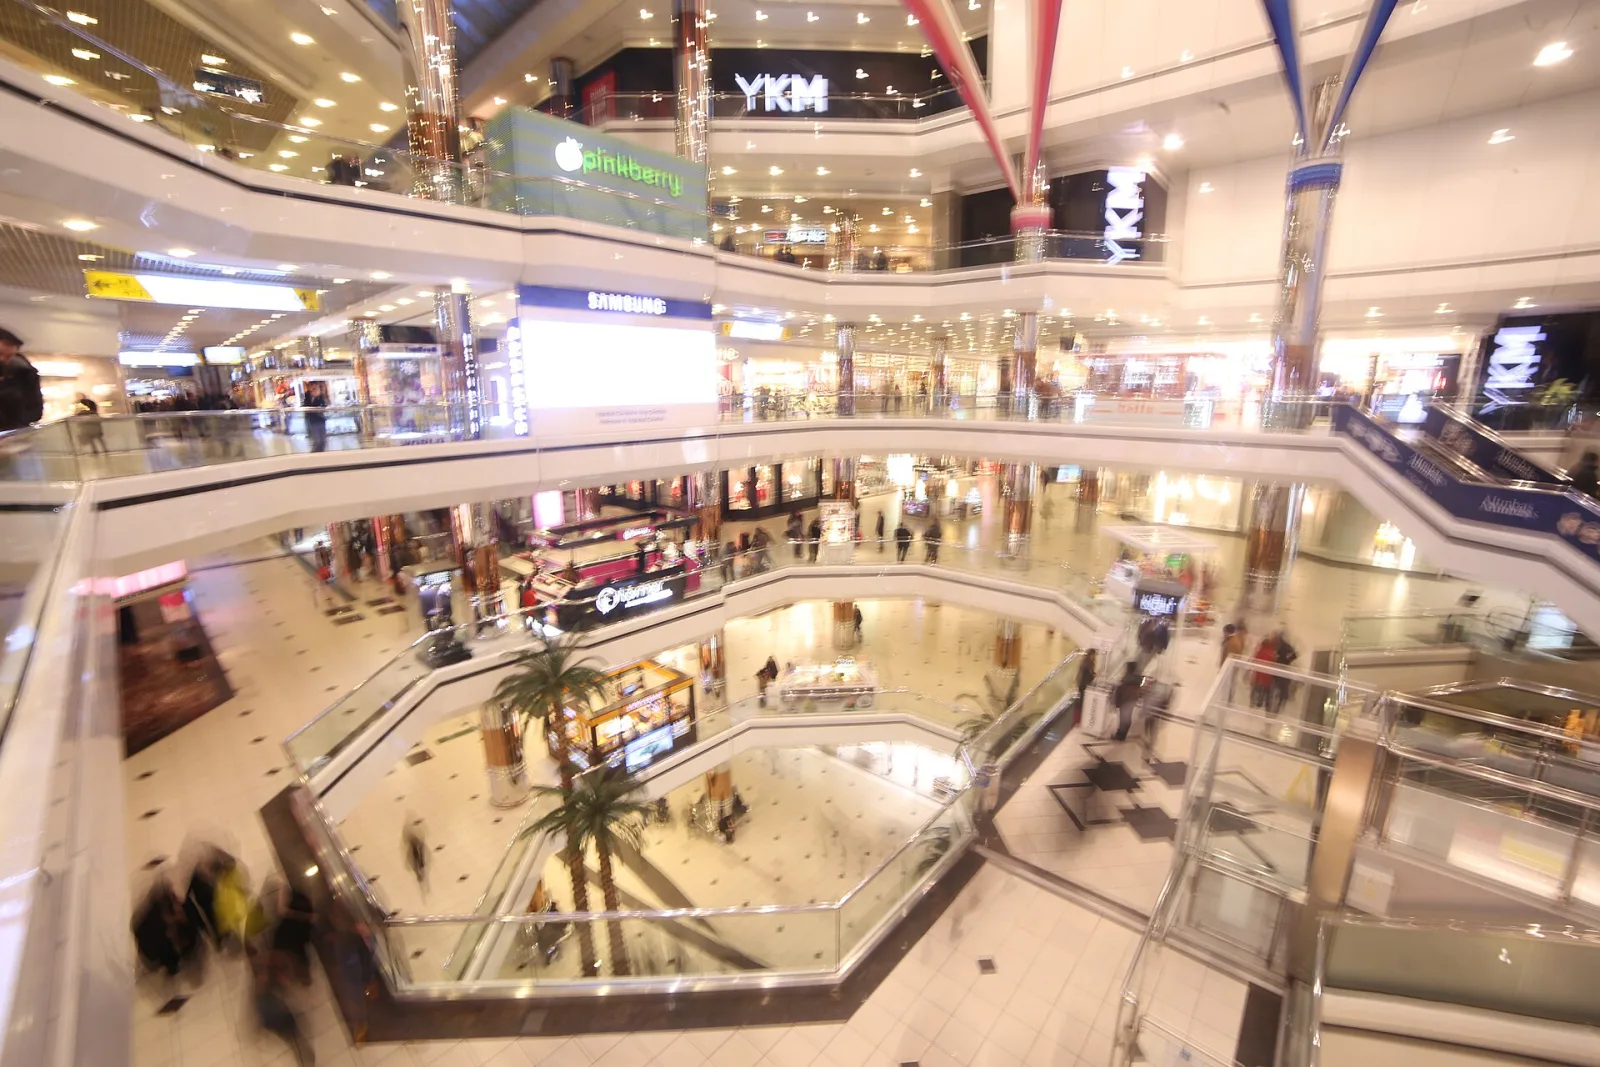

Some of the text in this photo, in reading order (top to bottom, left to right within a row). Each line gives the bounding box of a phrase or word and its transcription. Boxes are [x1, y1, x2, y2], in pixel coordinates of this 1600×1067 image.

[735, 72, 829, 114] YKM
[582, 147, 683, 197] pinkberry
[1103, 166, 1147, 266] YKM
[588, 291, 667, 315] SAMSUNG
[1479, 325, 1548, 414] YKM
